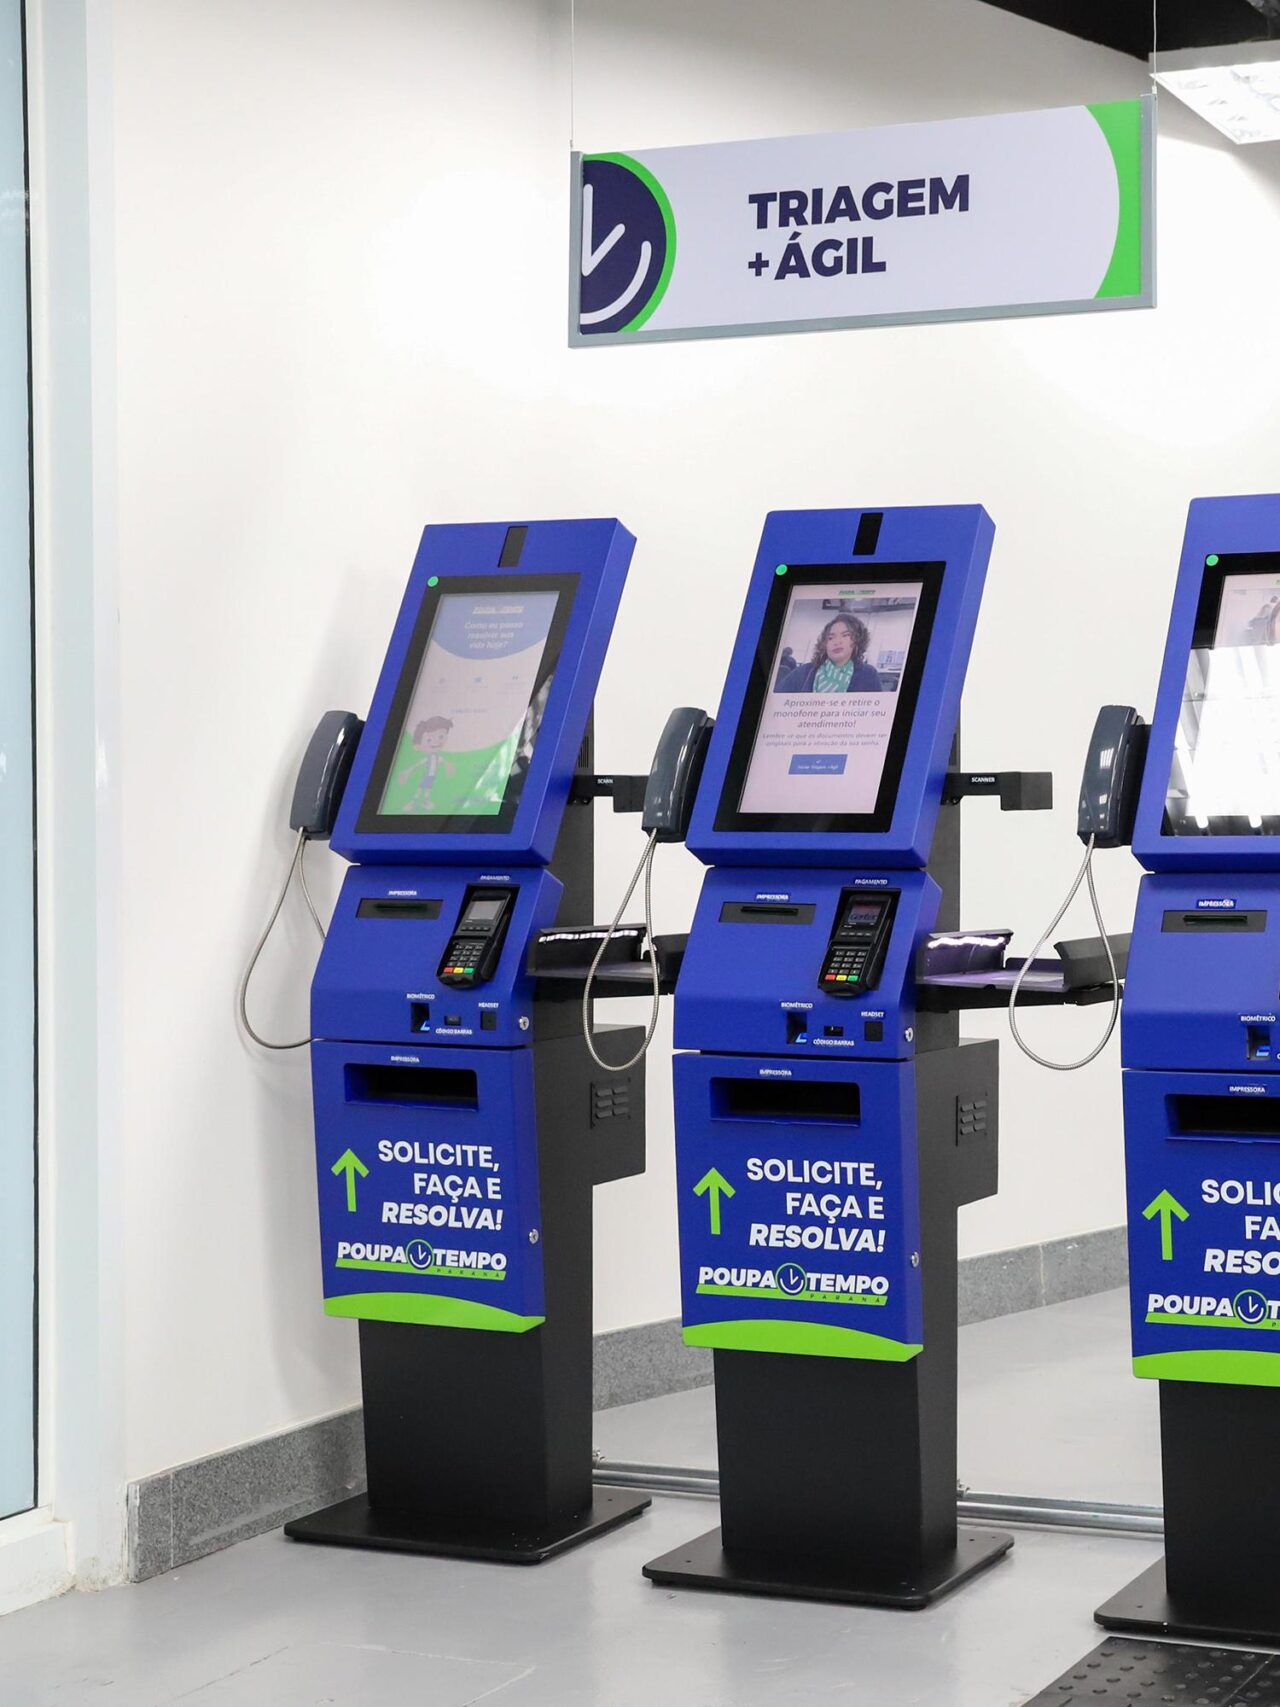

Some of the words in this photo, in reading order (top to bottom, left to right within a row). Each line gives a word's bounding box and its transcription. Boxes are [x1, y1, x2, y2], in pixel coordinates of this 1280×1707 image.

[748, 174, 969, 229] TRIAGEM
[773, 709, 818, 718] monofone
[820, 710, 840, 719] para
[842, 709, 868, 717] iniciar
[784, 699, 838, 708] Aproxime-se
[798, 720, 857, 728] atendimento!
[780, 1001, 814, 1009] BIOMÉTRICO
[1240, 1014, 1275, 1022] BIOMÉTRICO
[1229, 1085, 1265, 1093] IMPRESSORA
[378, 1140, 500, 1171] SOLICITE,
[413, 1173, 482, 1203] FAÇA
[487, 1177, 502, 1199] E
[746, 1158, 883, 1190] SOLICITE,
[381, 1202, 504, 1231] RESOLVA!
[786, 1192, 863, 1223] FAÇA
[868, 1196, 885, 1220] E
[749, 1223, 886, 1253] RESOLVA!
[337, 1241, 408, 1263] POUPA
[433, 1248, 507, 1270] TEMPO
[699, 1267, 777, 1289] POUPA
[806, 1272, 889, 1295] TEMPO
[1147, 1294, 1235, 1317] POUPA
